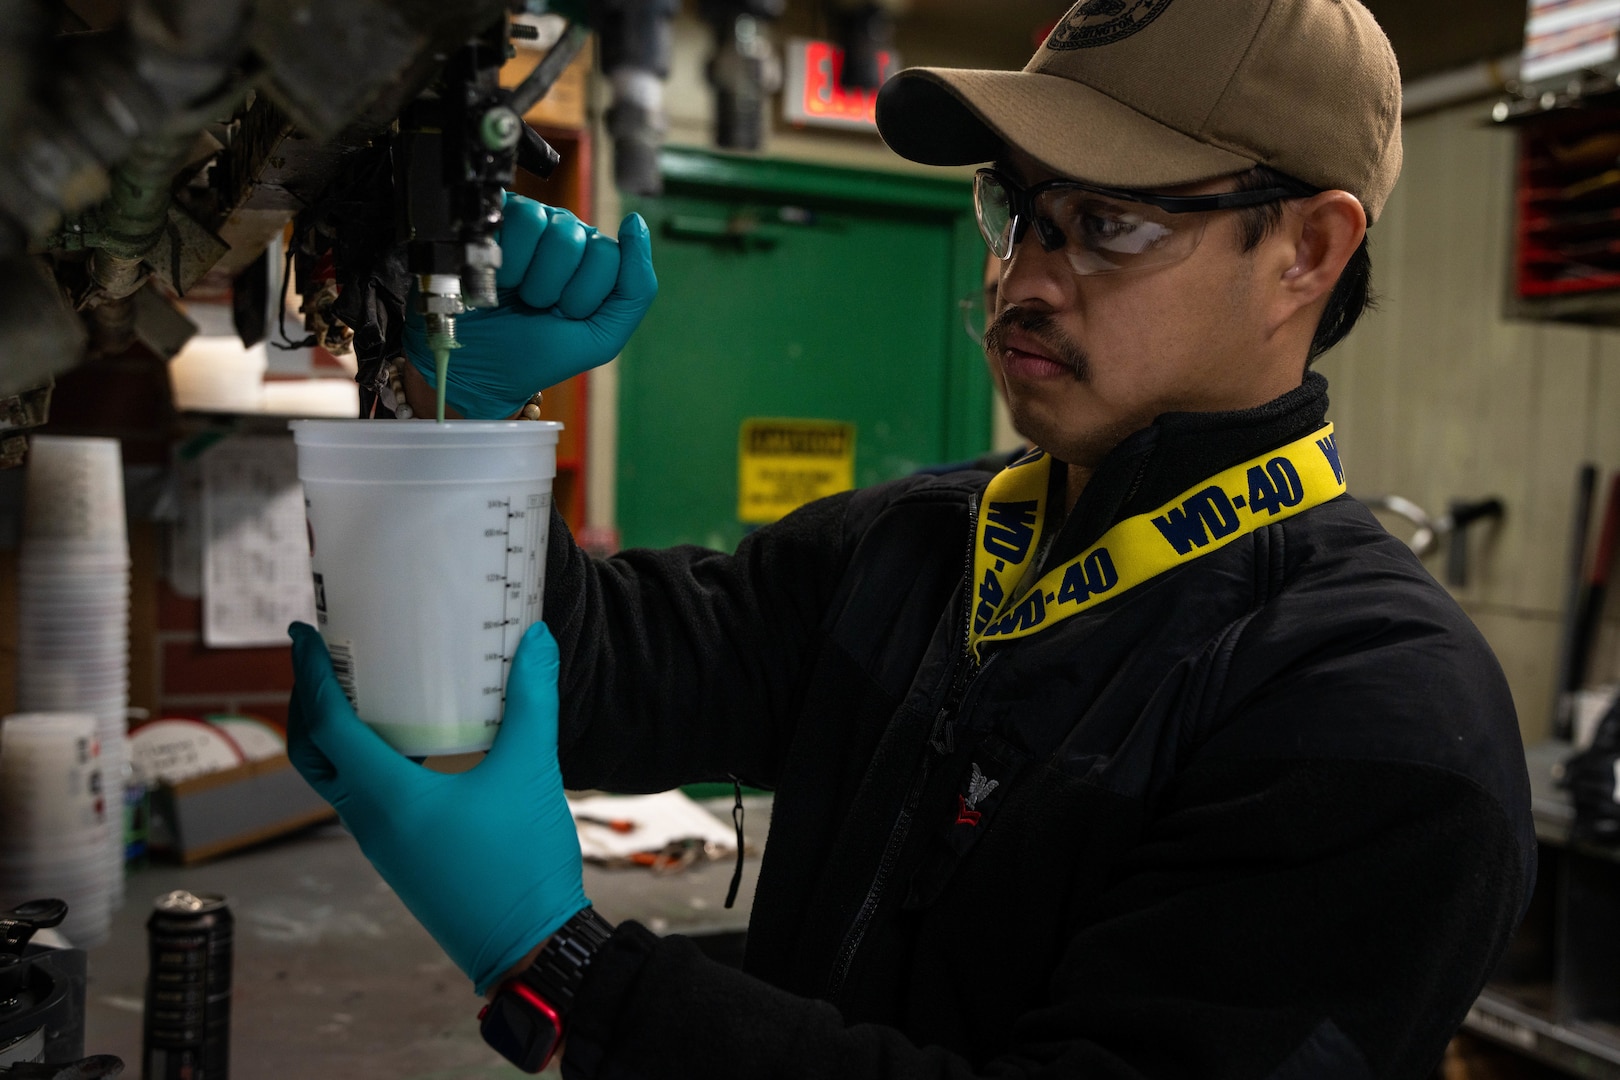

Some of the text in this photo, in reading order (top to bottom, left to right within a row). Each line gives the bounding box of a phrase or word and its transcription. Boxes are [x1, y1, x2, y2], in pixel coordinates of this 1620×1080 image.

[1150, 456, 1304, 556] WD-40
[974, 500, 1039, 635] WD-40
[983, 547, 1119, 636] WD-40
